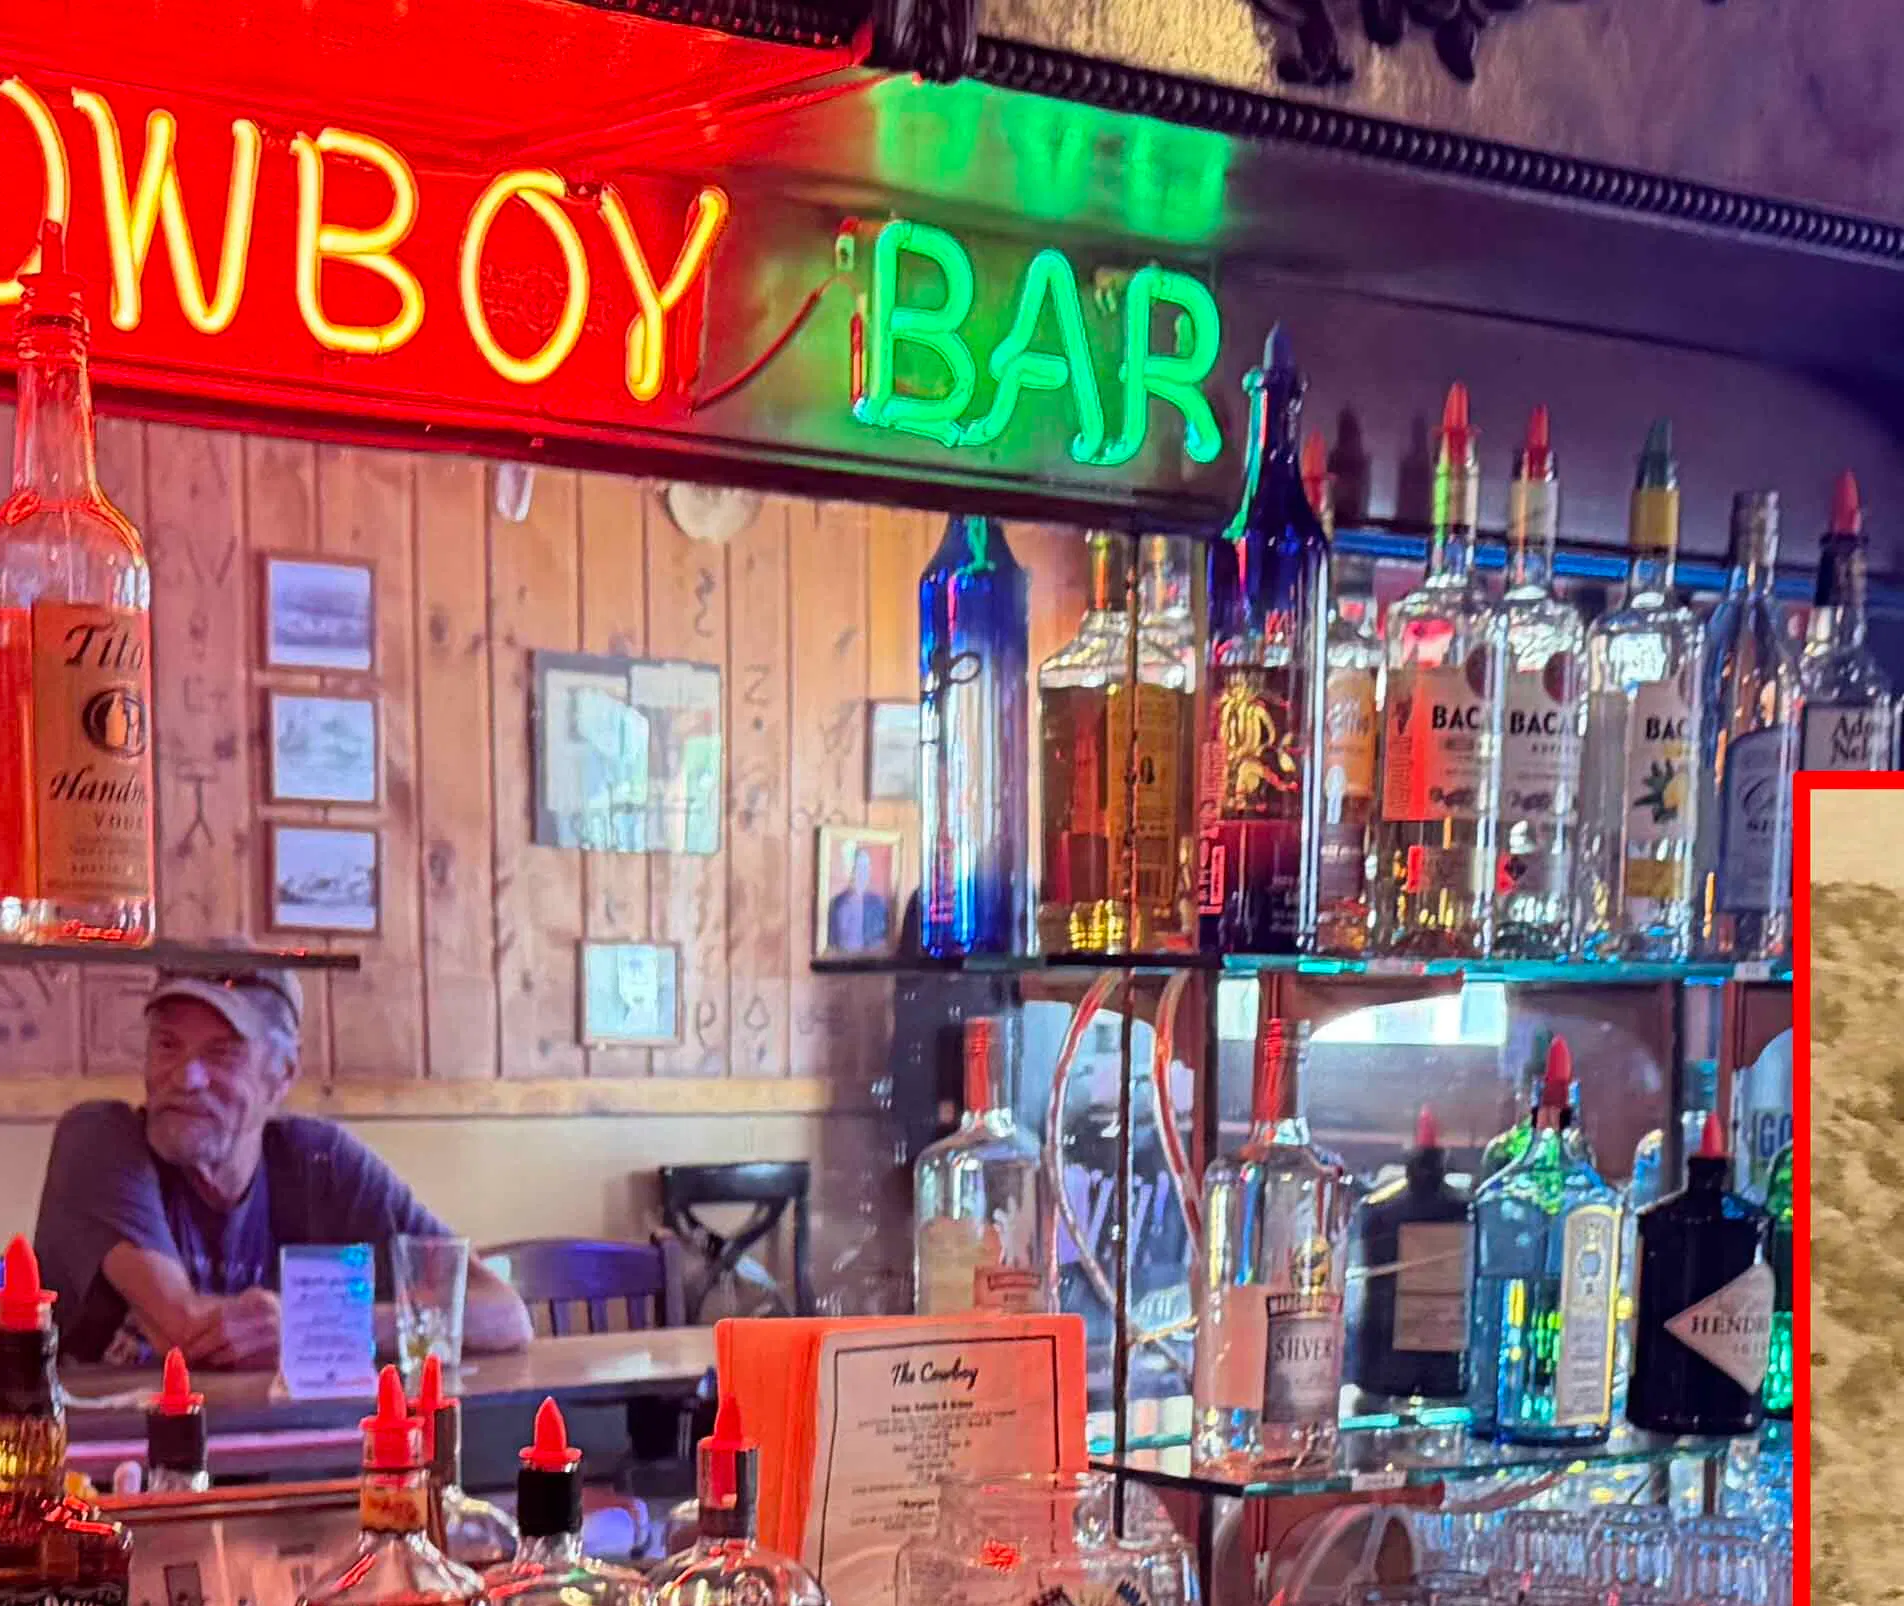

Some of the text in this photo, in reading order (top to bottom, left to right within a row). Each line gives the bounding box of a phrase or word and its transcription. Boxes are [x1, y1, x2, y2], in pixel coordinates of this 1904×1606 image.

[854, 217, 1224, 465] BAR
[1275, 1334, 1335, 1362] SILVER
[891, 1356, 979, 1392] The Cowboy
